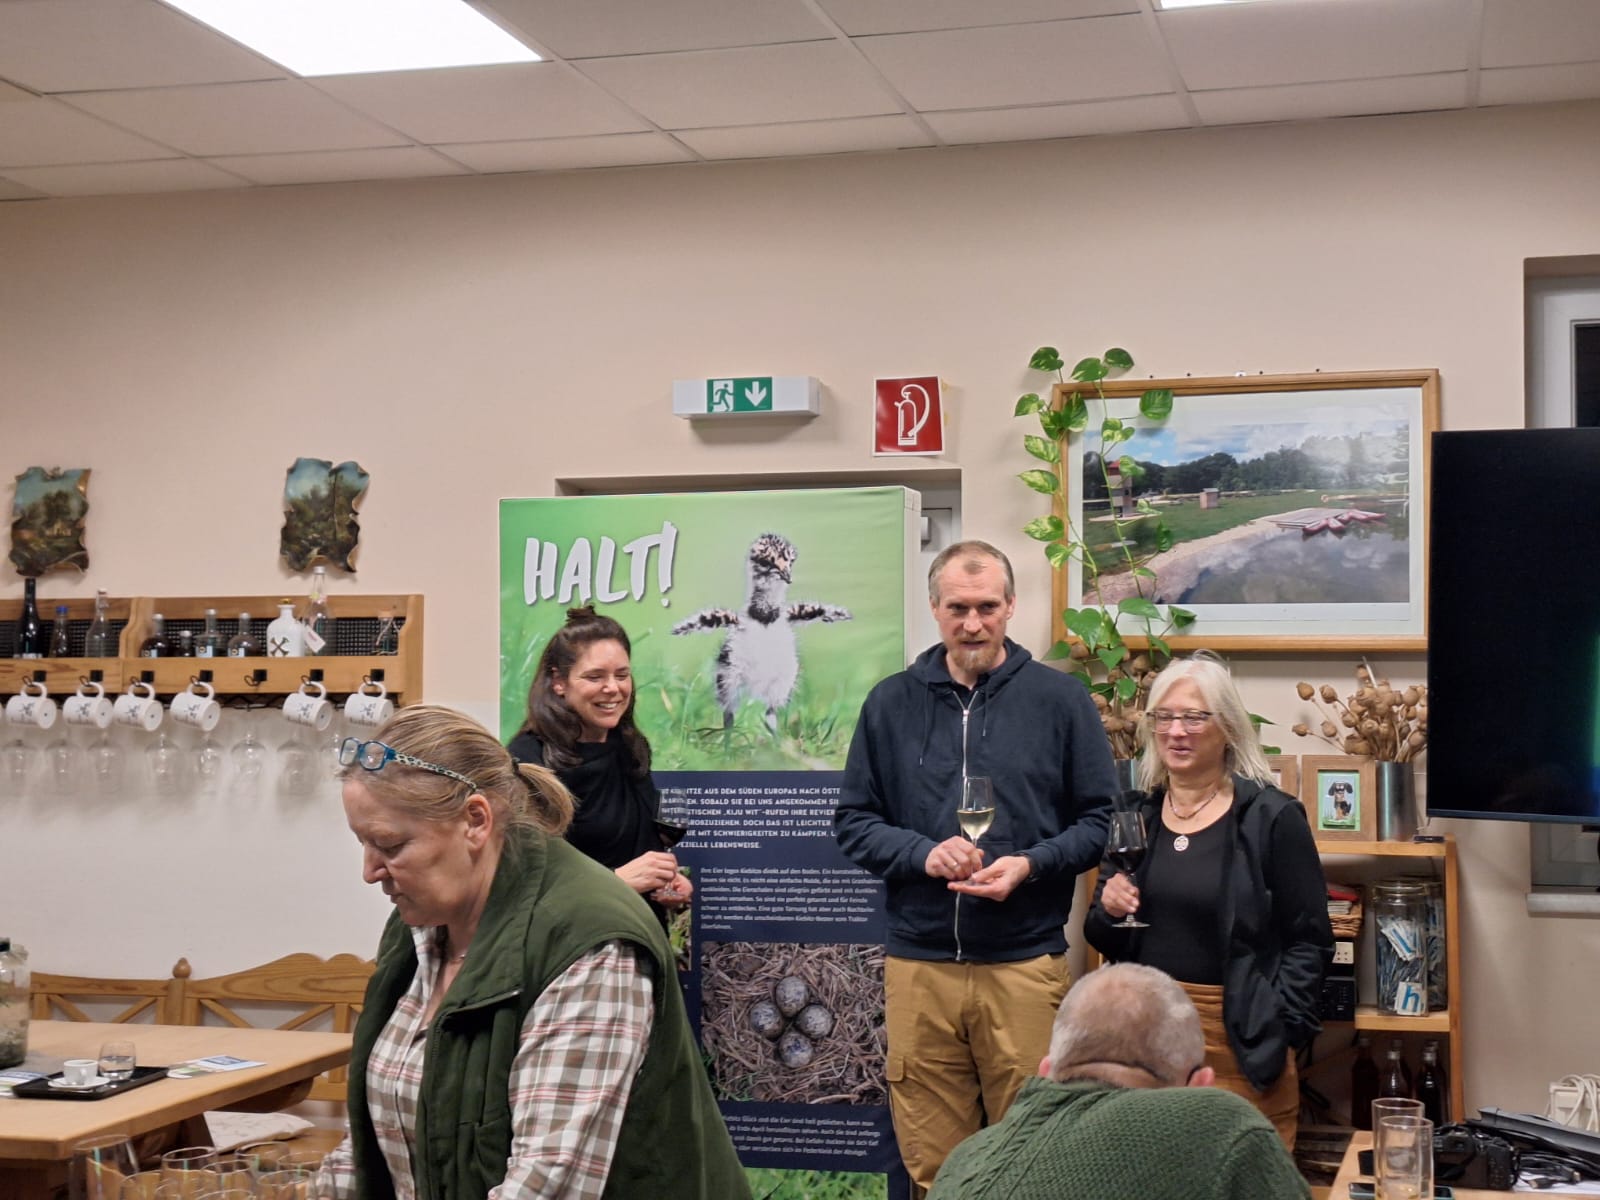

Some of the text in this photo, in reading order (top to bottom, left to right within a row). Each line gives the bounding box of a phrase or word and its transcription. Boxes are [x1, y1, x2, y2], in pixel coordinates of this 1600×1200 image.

[524, 520, 678, 607] HALT!
[687, 786, 840, 795] ITZE AUS DEM SÜDEN EUROPAS NACH ÖSTE
